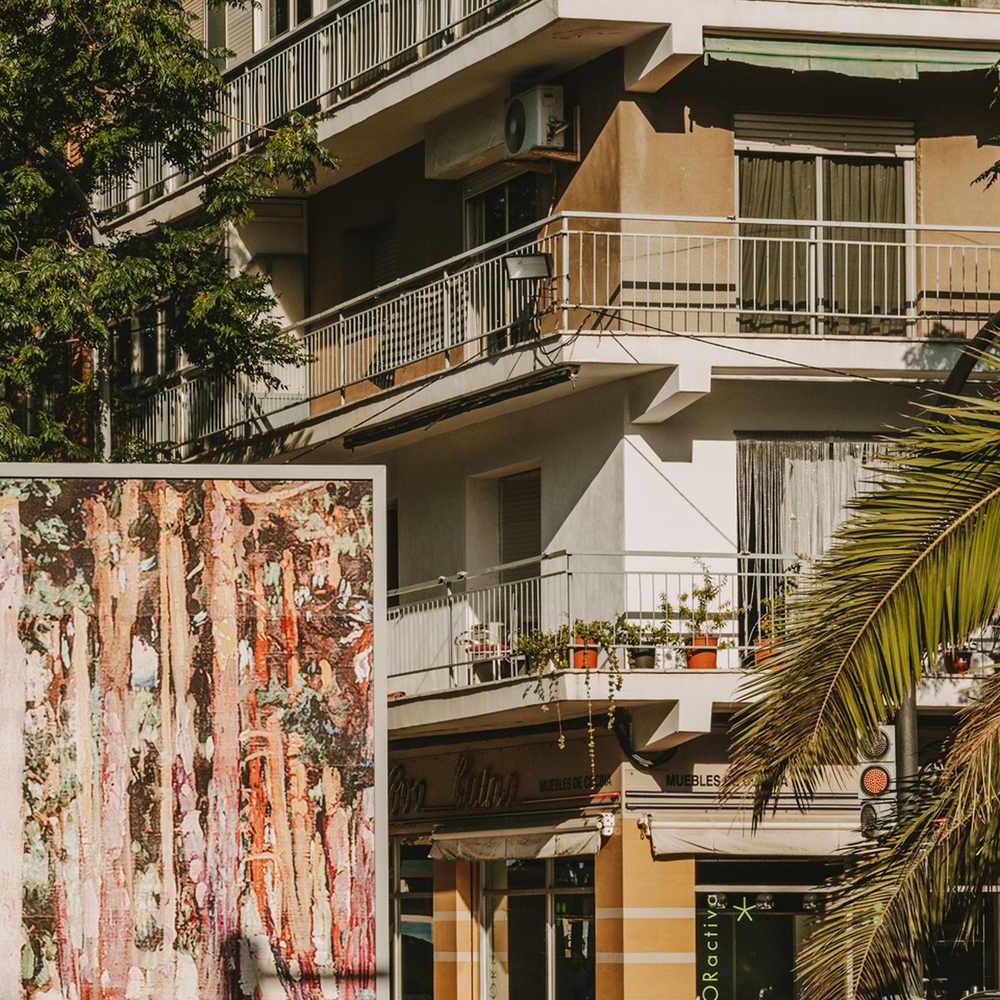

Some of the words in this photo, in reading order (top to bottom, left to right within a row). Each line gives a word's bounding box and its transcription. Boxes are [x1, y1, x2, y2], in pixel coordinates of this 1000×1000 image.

[539, 777, 572, 792] MUEBLES
[573, 776, 583, 790] DE
[666, 774, 721, 787] MUEBLES
